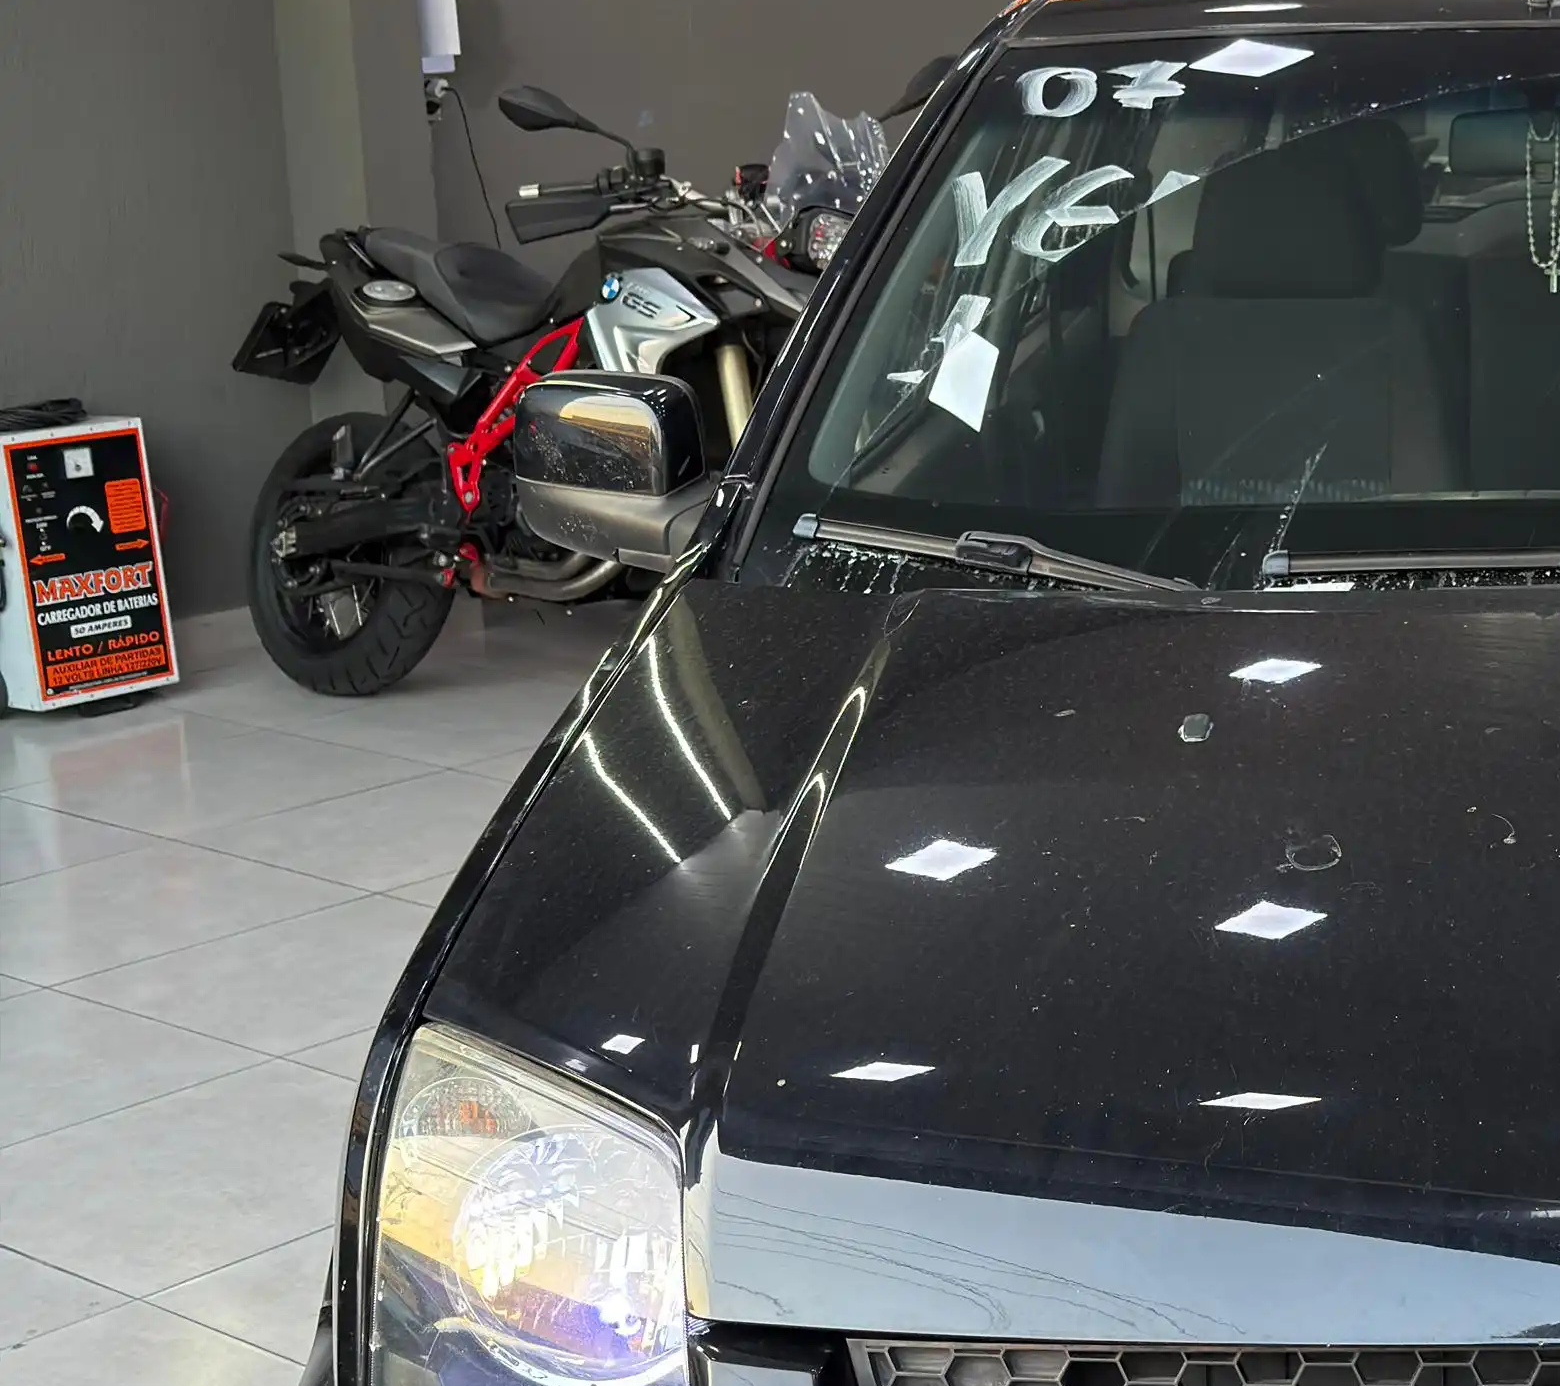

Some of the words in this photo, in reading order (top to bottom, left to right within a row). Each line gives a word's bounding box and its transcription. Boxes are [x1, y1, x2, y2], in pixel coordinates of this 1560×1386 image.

[622, 292, 662, 320] GS
[33, 561, 153, 606] MAXFORT
[37, 604, 101, 626] CARREGADOR
[103, 601, 116, 614] DE
[117, 593, 159, 611] BATERIAS
[87, 619, 129, 633] AMPERES
[47, 644, 93, 662] LENTO
[108, 631, 160, 650] RÁPIDO
[51, 657, 97, 675] AUXILIAR
[100, 654, 113, 666] DE
[115, 646, 161, 664] PARTIDAS
